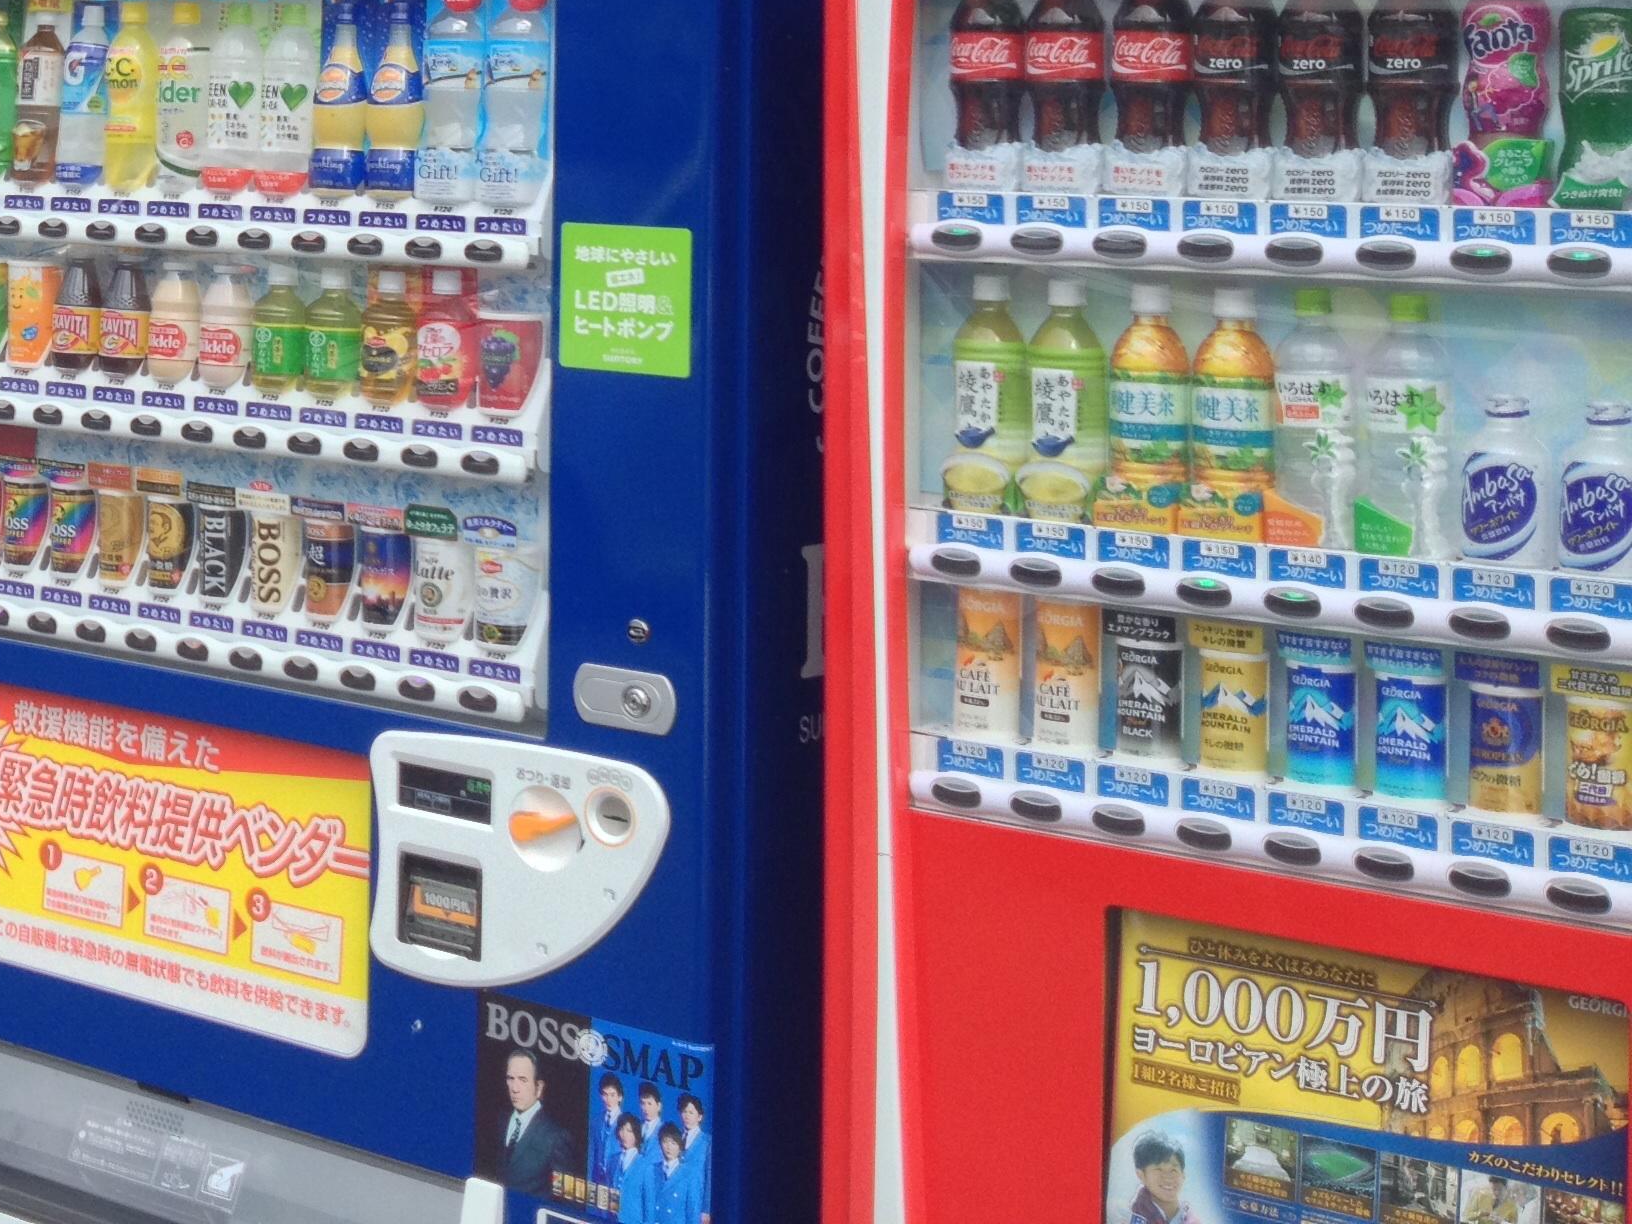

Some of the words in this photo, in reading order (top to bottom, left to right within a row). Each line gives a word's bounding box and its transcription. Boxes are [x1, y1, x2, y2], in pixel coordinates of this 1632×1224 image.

[1026, 36, 1093, 64] Coca-Cola
[1112, 36, 1182, 66] Coca-Cola
[1208, 55, 1243, 70] zero
[1292, 56, 1327, 71] zero
[1385, 56, 1422, 71] zero
[1567, 48, 1632, 92] Sprite
[418, 164, 459, 181] Gift!
[479, 167, 518, 184] Gift!
[956, 196, 985, 206] ¥150
[1037, 197, 1066, 207] ¥150
[1119, 201, 1149, 211] ¥150
[151, 206, 186, 216] つめたい
[1204, 204, 1234, 214] ¥150
[1292, 206, 1323, 217] ¥150
[1384, 208, 1416, 219] ¥150
[362, 216, 405, 228] つめたい
[1478, 212, 1511, 223] ¥150
[1575, 214, 1610, 225] ¥150
[574, 245, 678, 266] 地球にやさしい
[574, 315, 675, 342] ヒートポンプ
[149, 334, 180, 349] ikkle
[199, 339, 235, 354] ikkle
[50, 387, 83, 397] つめたい
[958, 369, 979, 418] 綾鷹
[1278, 380, 1332, 396] いろはす
[980, 367, 993, 424] あやたか
[1034, 375, 1056, 427] 綾鷹
[1058, 374, 1072, 432] あやたか
[250, 408, 289, 419] つめたい
[475, 431, 520, 444] つめたい
[1483, 487, 1527, 514] アンバサ
[1581, 498, 1626, 525] アンバサ
[8, 517, 29, 531] OSS
[955, 517, 983, 528] ¥150
[53, 523, 76, 538] OSS
[1035, 526, 1065, 538] ¥150
[1119, 535, 1149, 547] ¥150
[204, 511, 227, 594] BLACK
[1204, 545, 1235, 557] ¥150
[257, 520, 282, 604] BOSS
[1291, 552, 1322, 565] ¥140
[1381, 562, 1415, 575] ¥120
[1477, 573, 1511, 585] ¥120
[1574, 583, 1610, 595] ¥120
[93, 601, 127, 612] つめたい
[1117, 614, 1160, 627] 豊かな香り
[1108, 623, 1171, 639] エメマンブラック
[300, 636, 340, 649] つめたい
[1120, 650, 1159, 665] GEORGIA
[1204, 662, 1244, 676] GEORGIA
[1291, 674, 1331, 688] GEORGIA
[1571, 669, 1618, 684] 甘さ控えめ
[969, 682, 1001, 696] LAIT
[1381, 686, 1422, 700] GEORGIA
[1049, 697, 1081, 711] LAIT
[12, 699, 221, 774] 救援機能を備えた
[1122, 726, 1153, 738] BLACK
[955, 745, 984, 756] ¥120
[1035, 757, 1066, 770] ¥120
[1118, 771, 1148, 784] ¥120
[1203, 784, 1233, 796] ¥120
[1290, 798, 1322, 811] ¥120
[1381, 813, 1414, 826] ¥120
[1476, 828, 1509, 841] ¥120
[47, 844, 55, 866] 1
[1575, 843, 1609, 856] ¥120
[145, 868, 157, 889] 2
[252, 893, 264, 913] 3
[1189, 937, 1375, 988] ひと休みをよくばるあなたに
[1134, 959, 1434, 1074] 1,000万円
[486, 1002, 580, 1061] BOSS
[597, 1032, 704, 1092] SMAP
[1132, 1025, 1431, 1115] ヨーロピアン極上の旅
[1132, 1062, 1241, 1101] 1組2名様ご招待
[1468, 1149, 1624, 1199] カズのこだわりセレクト!!
